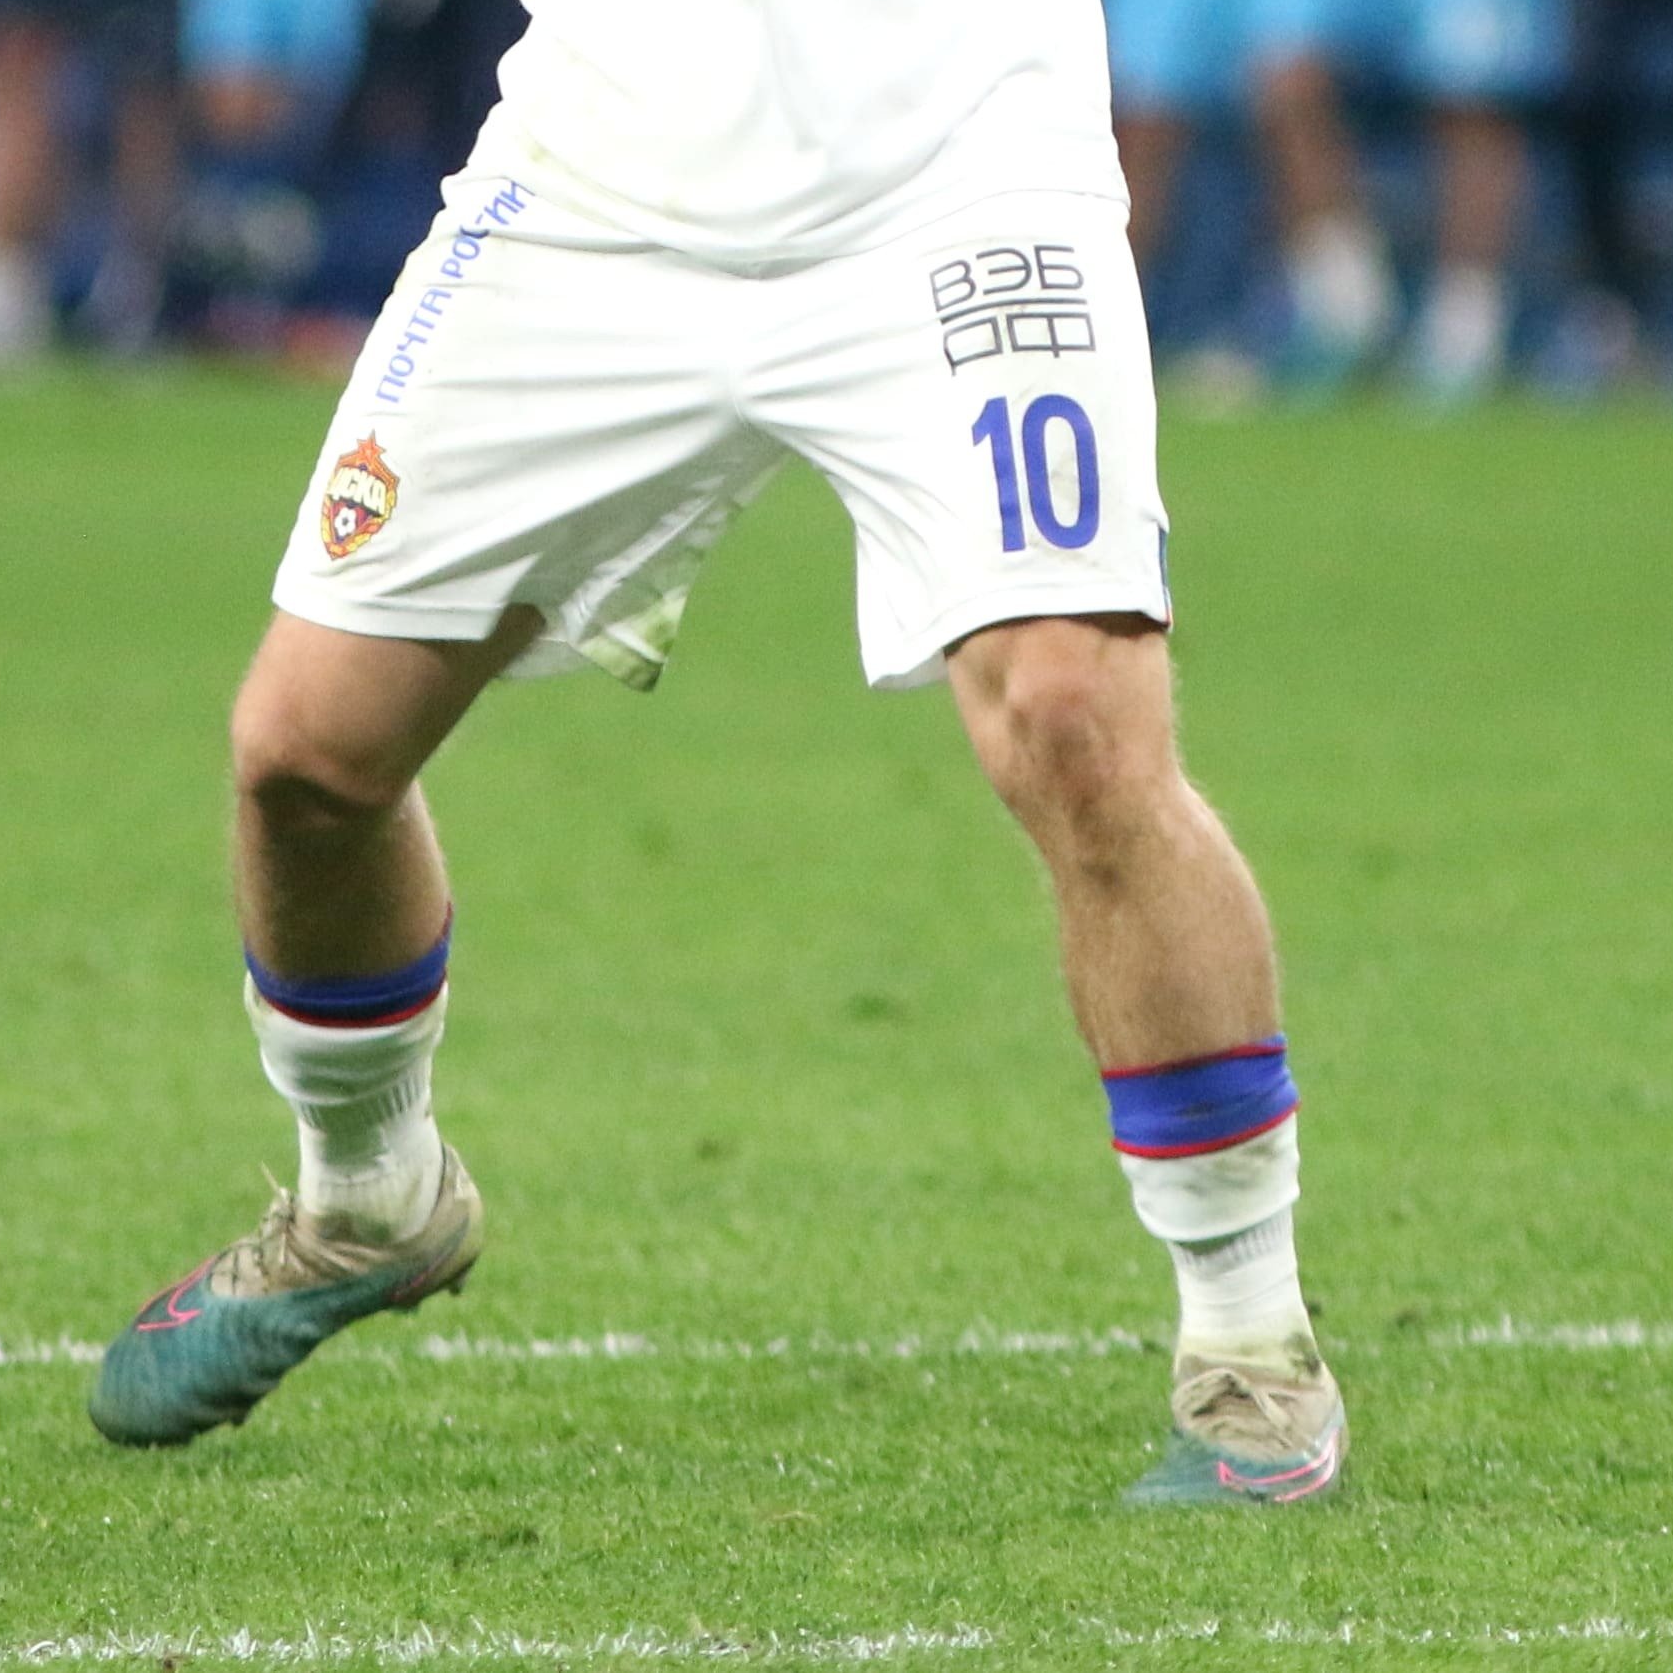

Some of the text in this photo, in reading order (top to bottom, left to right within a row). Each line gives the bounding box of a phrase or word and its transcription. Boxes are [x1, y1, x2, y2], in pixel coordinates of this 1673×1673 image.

[375, 181, 536, 404] ПОЧТА РОСИИ
[929, 244, 1084, 313] ВЭБ
[942, 312, 1097, 377] РФ
[971, 393, 1100, 553] 10
